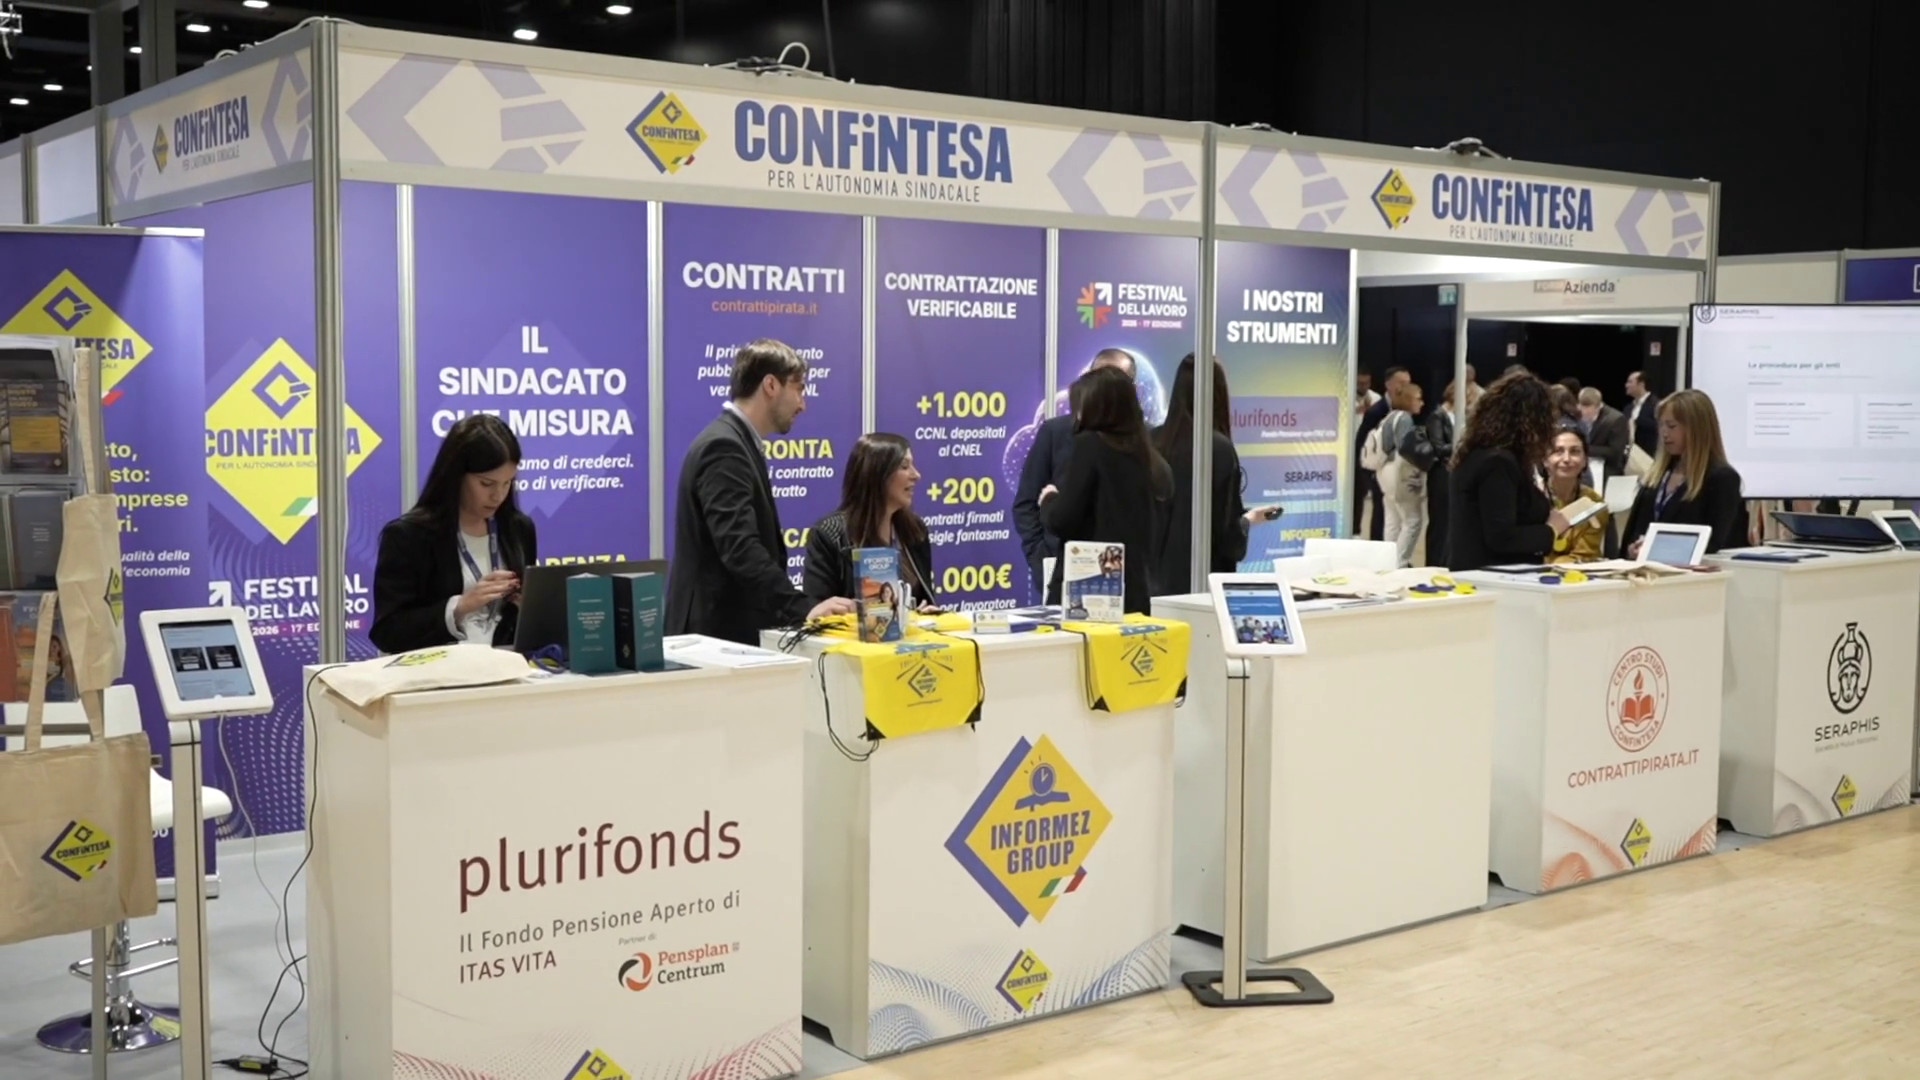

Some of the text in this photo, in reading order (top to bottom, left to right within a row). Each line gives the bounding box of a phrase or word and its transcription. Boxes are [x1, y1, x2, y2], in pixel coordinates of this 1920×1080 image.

[735, 100, 1012, 184] CONFiNTESA
[768, 170, 980, 202] PER L'AUTONOMIA SINDACALE
[1432, 173, 1593, 232] CONFiNTESA
[1450, 224, 1574, 247] PER L'AUTONOMIA SINDACALE
[682, 261, 845, 293] CONTRATTI
[885, 272, 1038, 296] CONTRATTAZIONE
[1564, 280, 1615, 294] Azienda
[1118, 283, 1188, 302] FESTIVAL
[1243, 289, 1323, 313] I NOSTRI
[712, 300, 818, 316] contrattipirata.it
[907, 298, 1017, 319] VERIFICABILE
[1118, 302, 1187, 317] DEL LAVORO
[522, 326, 548, 353] IL
[1226, 321, 1338, 345] STRUMENTI
[705, 344, 713, 357] Il
[439, 367, 627, 395] SINDACATO
[808, 367, 830, 380] per
[916, 391, 1006, 418] +1.000
[508, 409, 634, 437] MISURA
[1231, 408, 1298, 428] lurifonds
[205, 428, 361, 457] CONFiNTA
[915, 426, 1006, 441] CCNL depositati
[553, 455, 567, 469] di
[570, 454, 634, 469] crederci.
[938, 444, 982, 457] al CNEL
[532, 476, 546, 490] di
[551, 475, 624, 493] verificare.
[775, 466, 834, 479] contratto
[1284, 471, 1333, 483] SERAPHIS
[926, 477, 994, 504] +200
[966, 510, 1004, 527] firmati
[956, 529, 1010, 545] fantasma
[157, 550, 190, 561] della
[244, 573, 369, 600] FESTIAL
[931, 563, 1012, 594] .000€
[245, 597, 369, 620] DEL LAVRO
[960, 598, 1016, 612] lavoratore
[252, 625, 279, 636] 2026
[1613, 652, 1664, 686] CENTRO STUDI
[1814, 716, 1880, 742] SERAPHIS
[1567, 749, 1699, 788] CONTRATTIPIRATA.IT
[990, 809, 1091, 850] INFORMEZ
[460, 810, 741, 914] plurifonds
[1007, 840, 1075, 875] GROUP
[460, 890, 740, 953] Il Fondo Pensione Aperto di
[658, 943, 729, 966] Pensplan
[460, 950, 557, 984] ITAS VITA
[657, 962, 725, 984] Centrum
